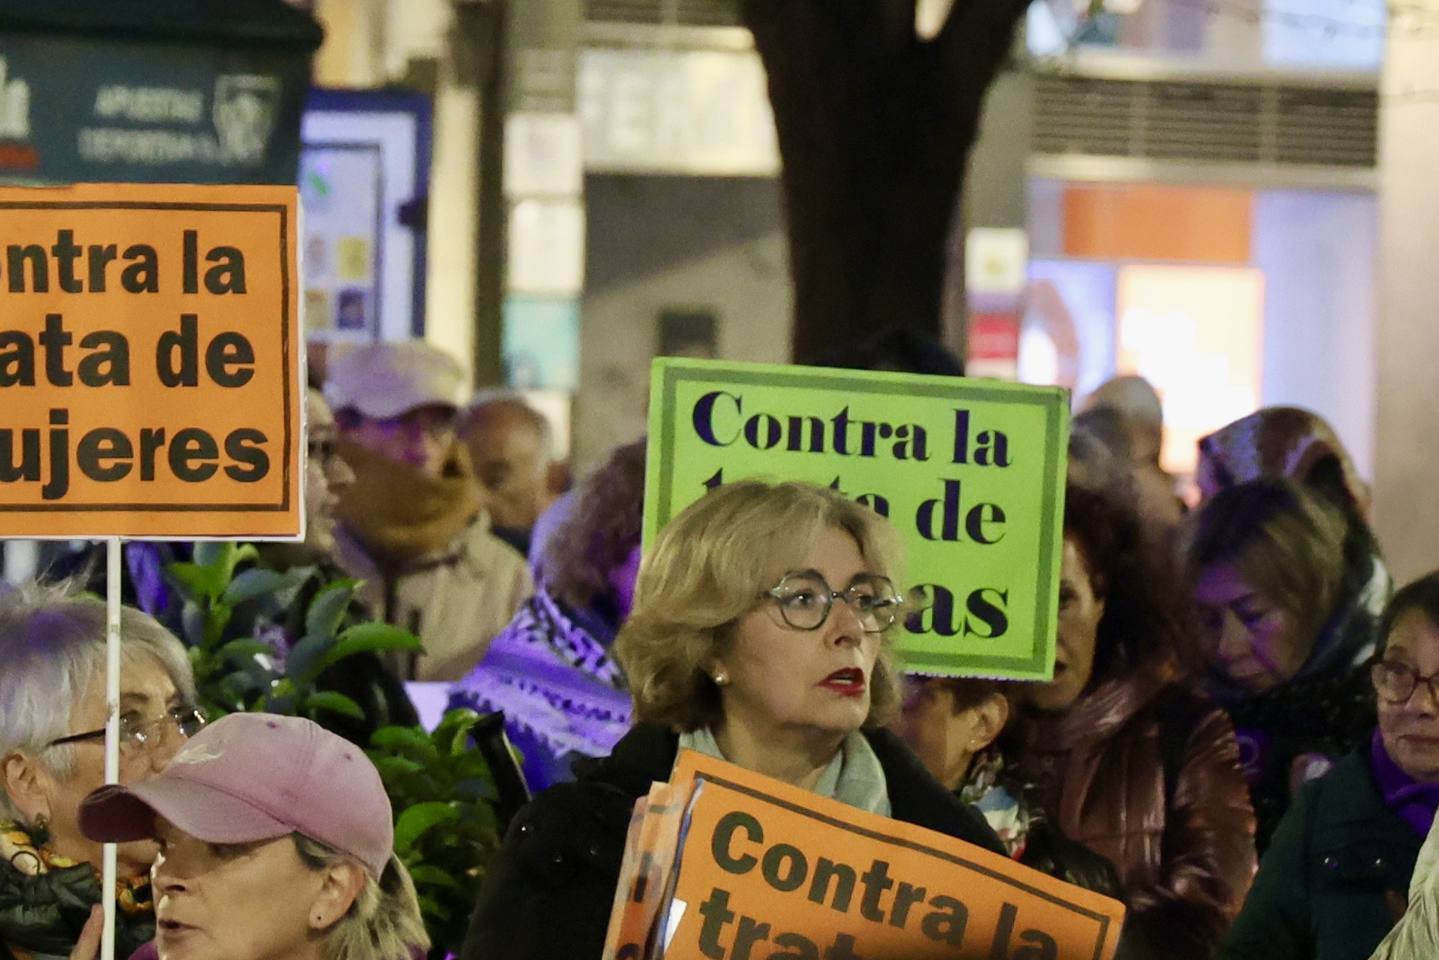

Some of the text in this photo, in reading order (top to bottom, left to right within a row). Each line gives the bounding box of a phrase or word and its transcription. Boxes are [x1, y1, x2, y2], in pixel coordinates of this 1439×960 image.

[182, 229, 248, 295] la
[155, 313, 256, 388] de
[692, 390, 1013, 469] Contra la
[915, 478, 1007, 545] de
[711, 810, 970, 949] Contra
